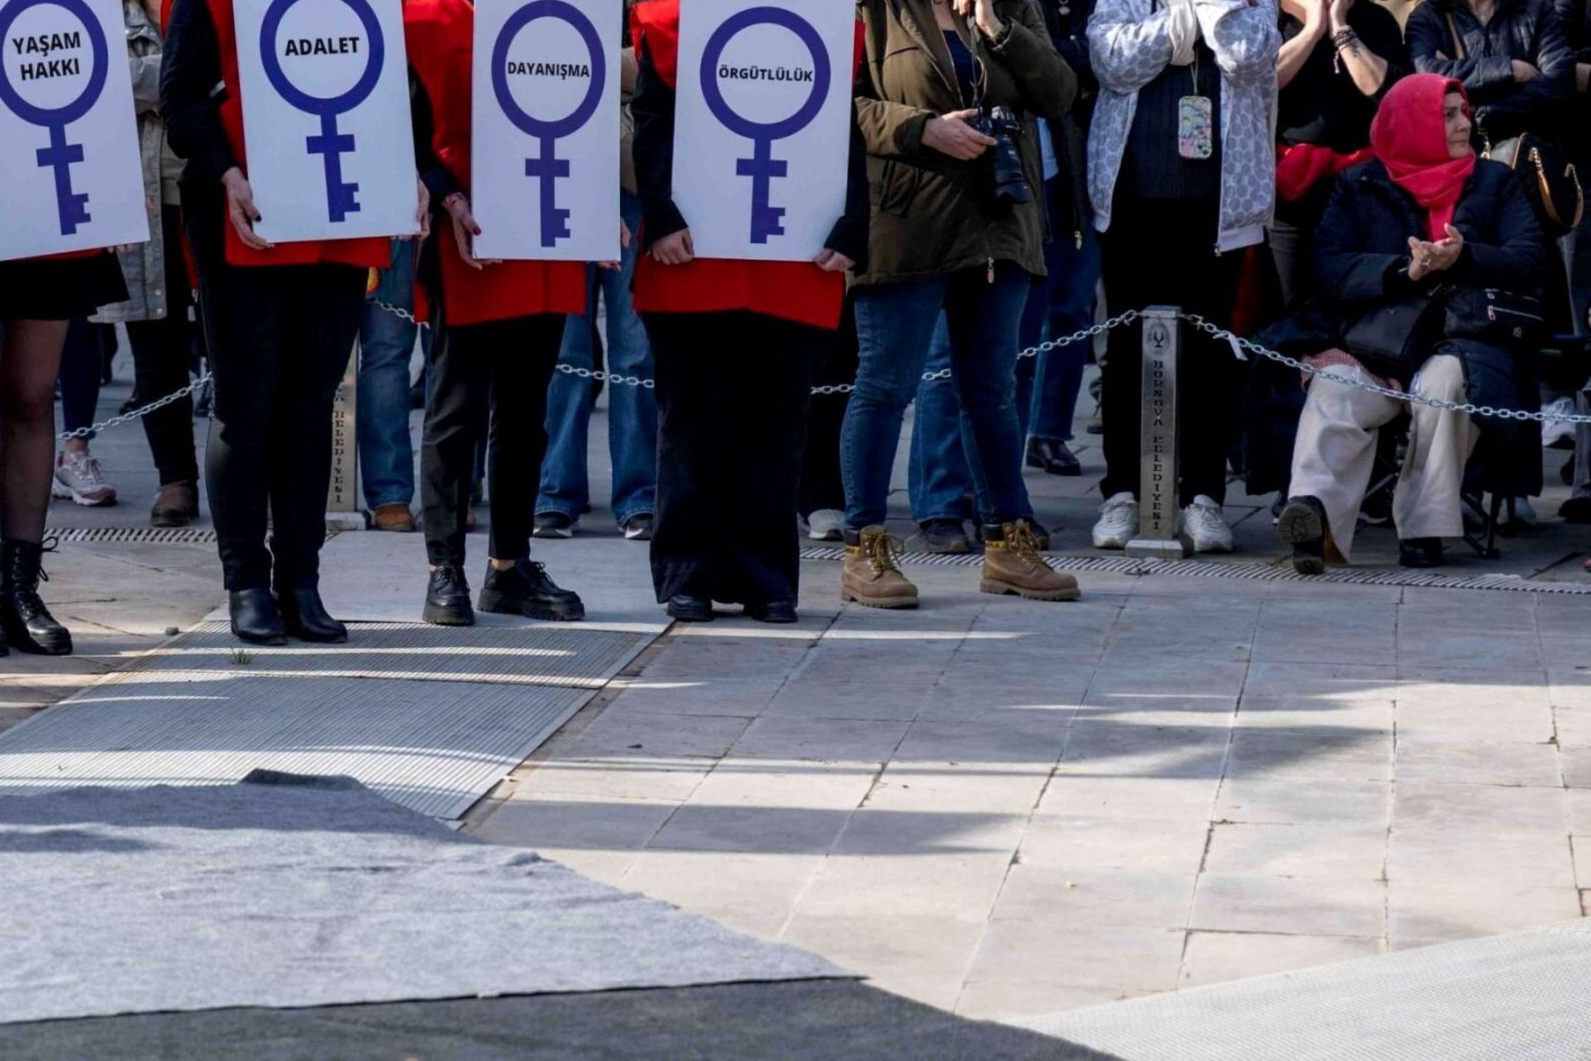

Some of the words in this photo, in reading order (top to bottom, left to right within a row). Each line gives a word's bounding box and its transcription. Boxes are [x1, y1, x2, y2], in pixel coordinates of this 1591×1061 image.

[12, 31, 81, 57] YAŞAM
[285, 36, 360, 56] ADALET
[20, 58, 80, 81] HAKKI
[507, 61, 590, 81] DAYANIŞMA
[718, 64, 813, 82] ÖRGÜTLÜLÜK
